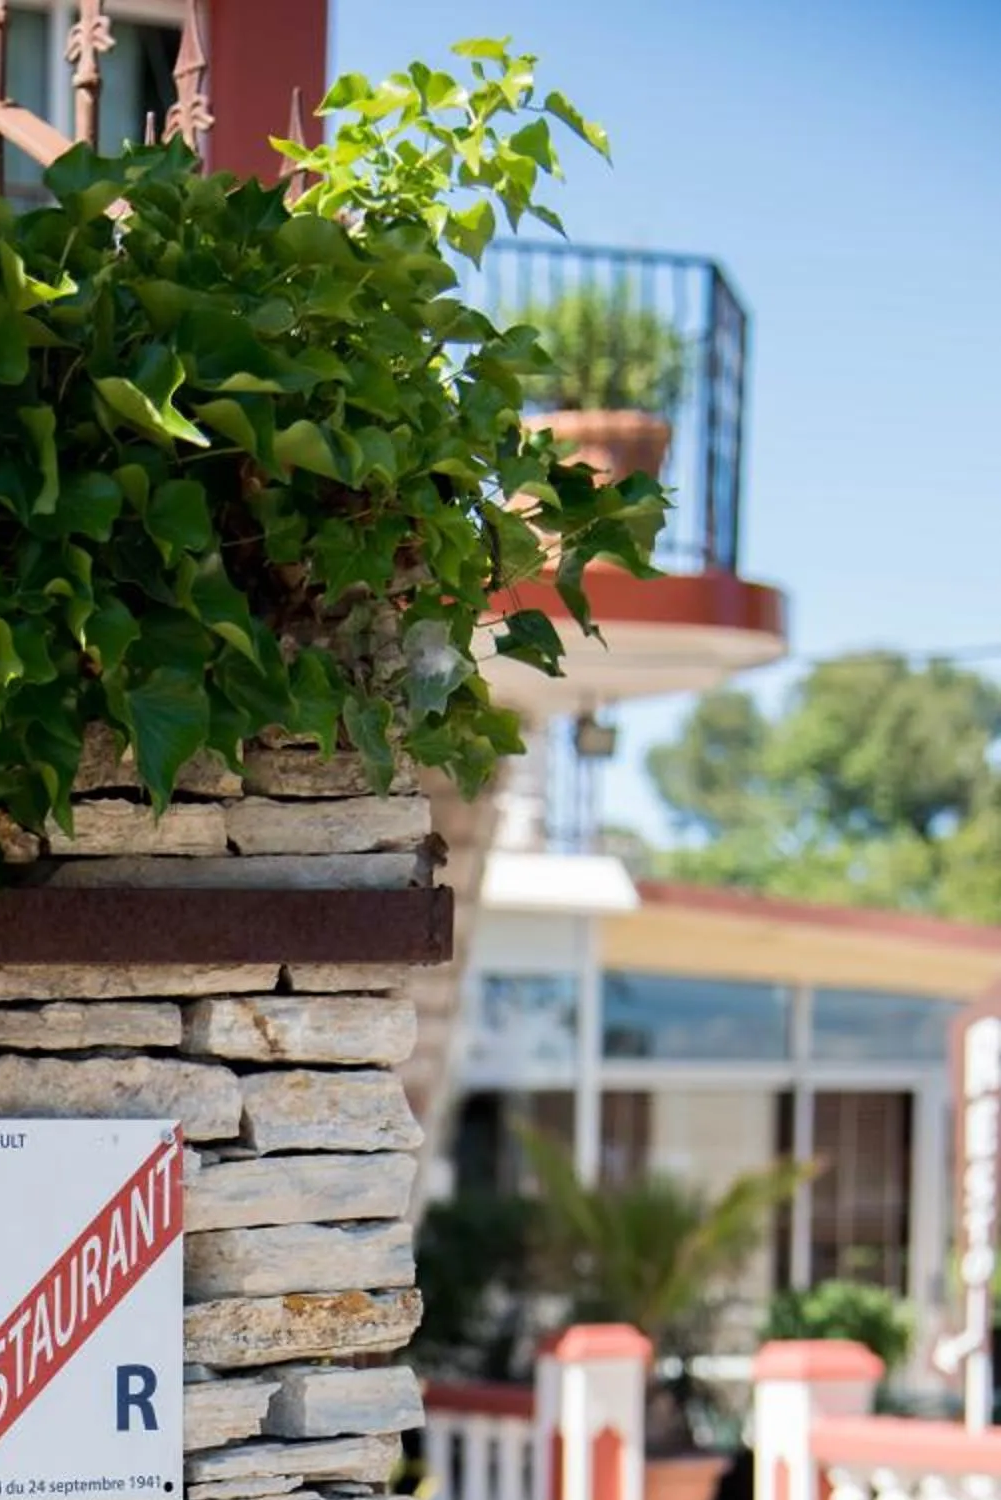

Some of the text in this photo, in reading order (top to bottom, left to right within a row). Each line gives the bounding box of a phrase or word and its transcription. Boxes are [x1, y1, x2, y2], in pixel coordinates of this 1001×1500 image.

[116, 1364, 158, 1431] R
[6, 1480, 24, 1495] du
[28, 1479, 45, 1493] 24
[49, 1475, 125, 1496] septembre
[129, 1475, 161, 1489] 1941
